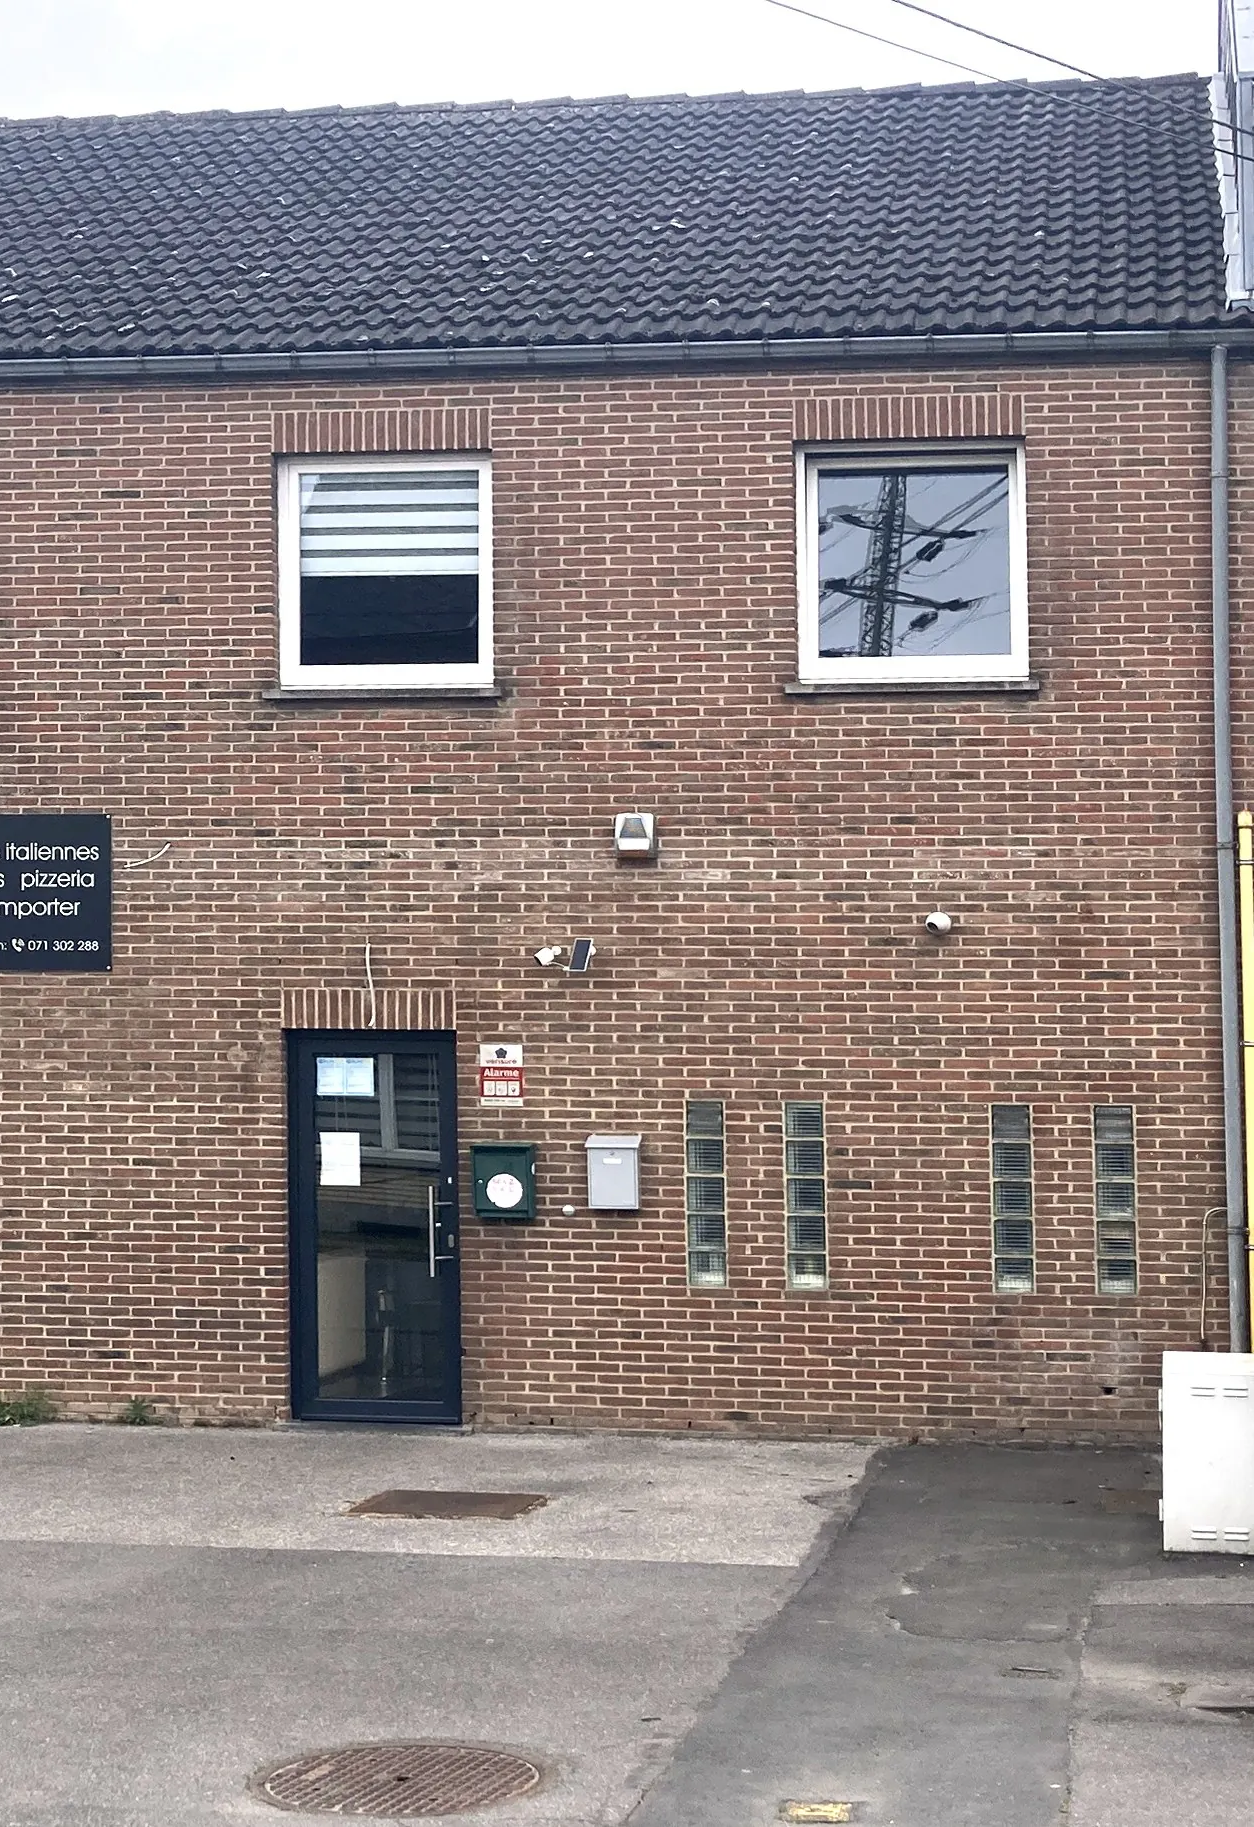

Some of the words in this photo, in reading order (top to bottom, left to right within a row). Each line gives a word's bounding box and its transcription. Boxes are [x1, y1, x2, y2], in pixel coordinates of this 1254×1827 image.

[5, 842, 100, 861] italiennes
[20, 869, 95, 891] pizzeria
[27, 940, 48, 951] 071
[52, 940, 75, 952] 302
[77, 940, 100, 952] 288
[483, 1068, 520, 1077] Alarme
